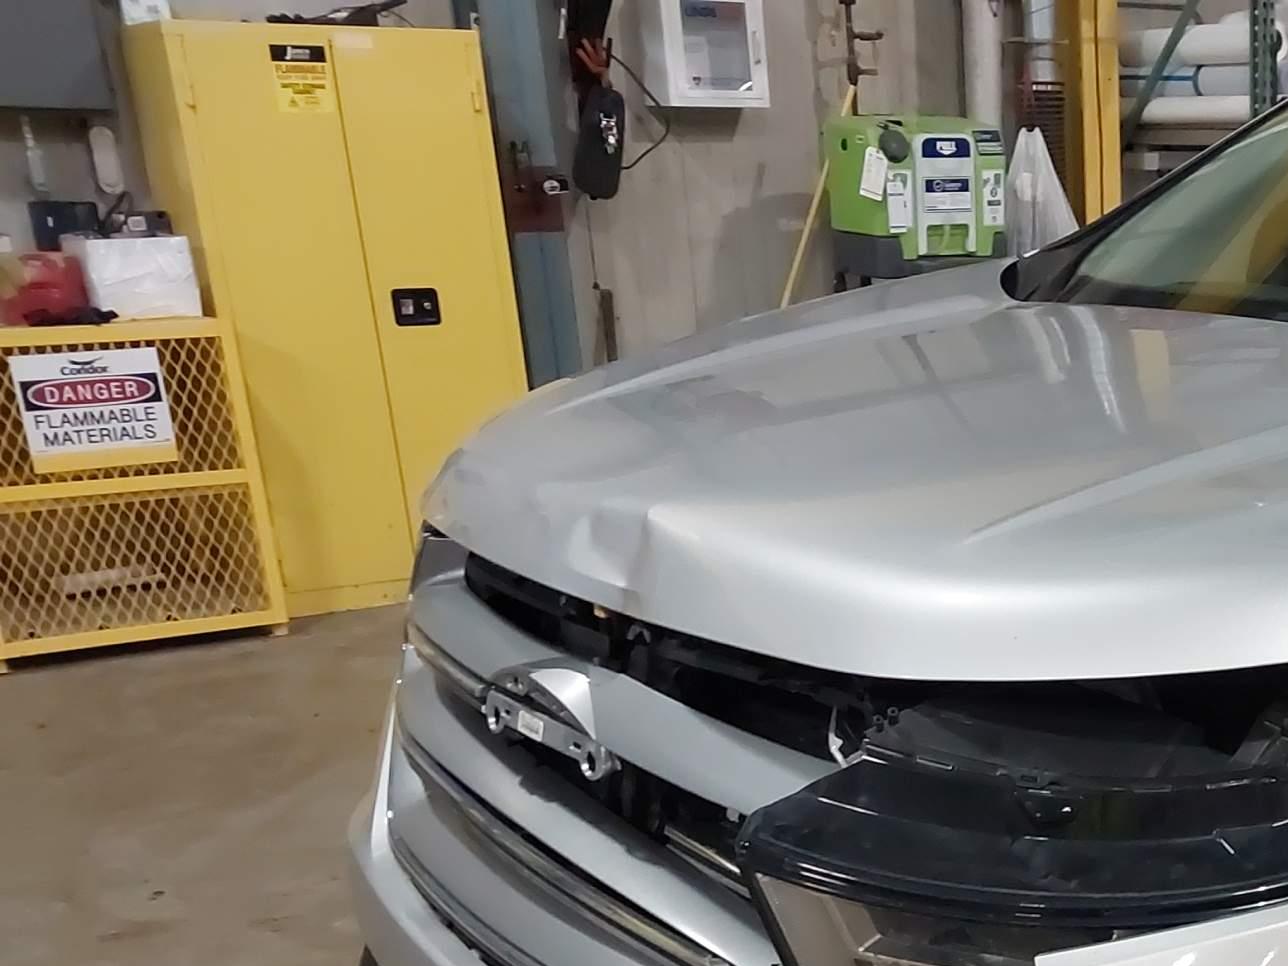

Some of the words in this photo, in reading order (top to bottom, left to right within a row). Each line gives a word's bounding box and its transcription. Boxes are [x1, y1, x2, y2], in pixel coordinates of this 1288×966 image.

[60, 365, 109, 376] Condor
[44, 381, 139, 403] DANGER
[34, 406, 158, 430] FLAMMABLE
[43, 424, 157, 447] MATERIALS
